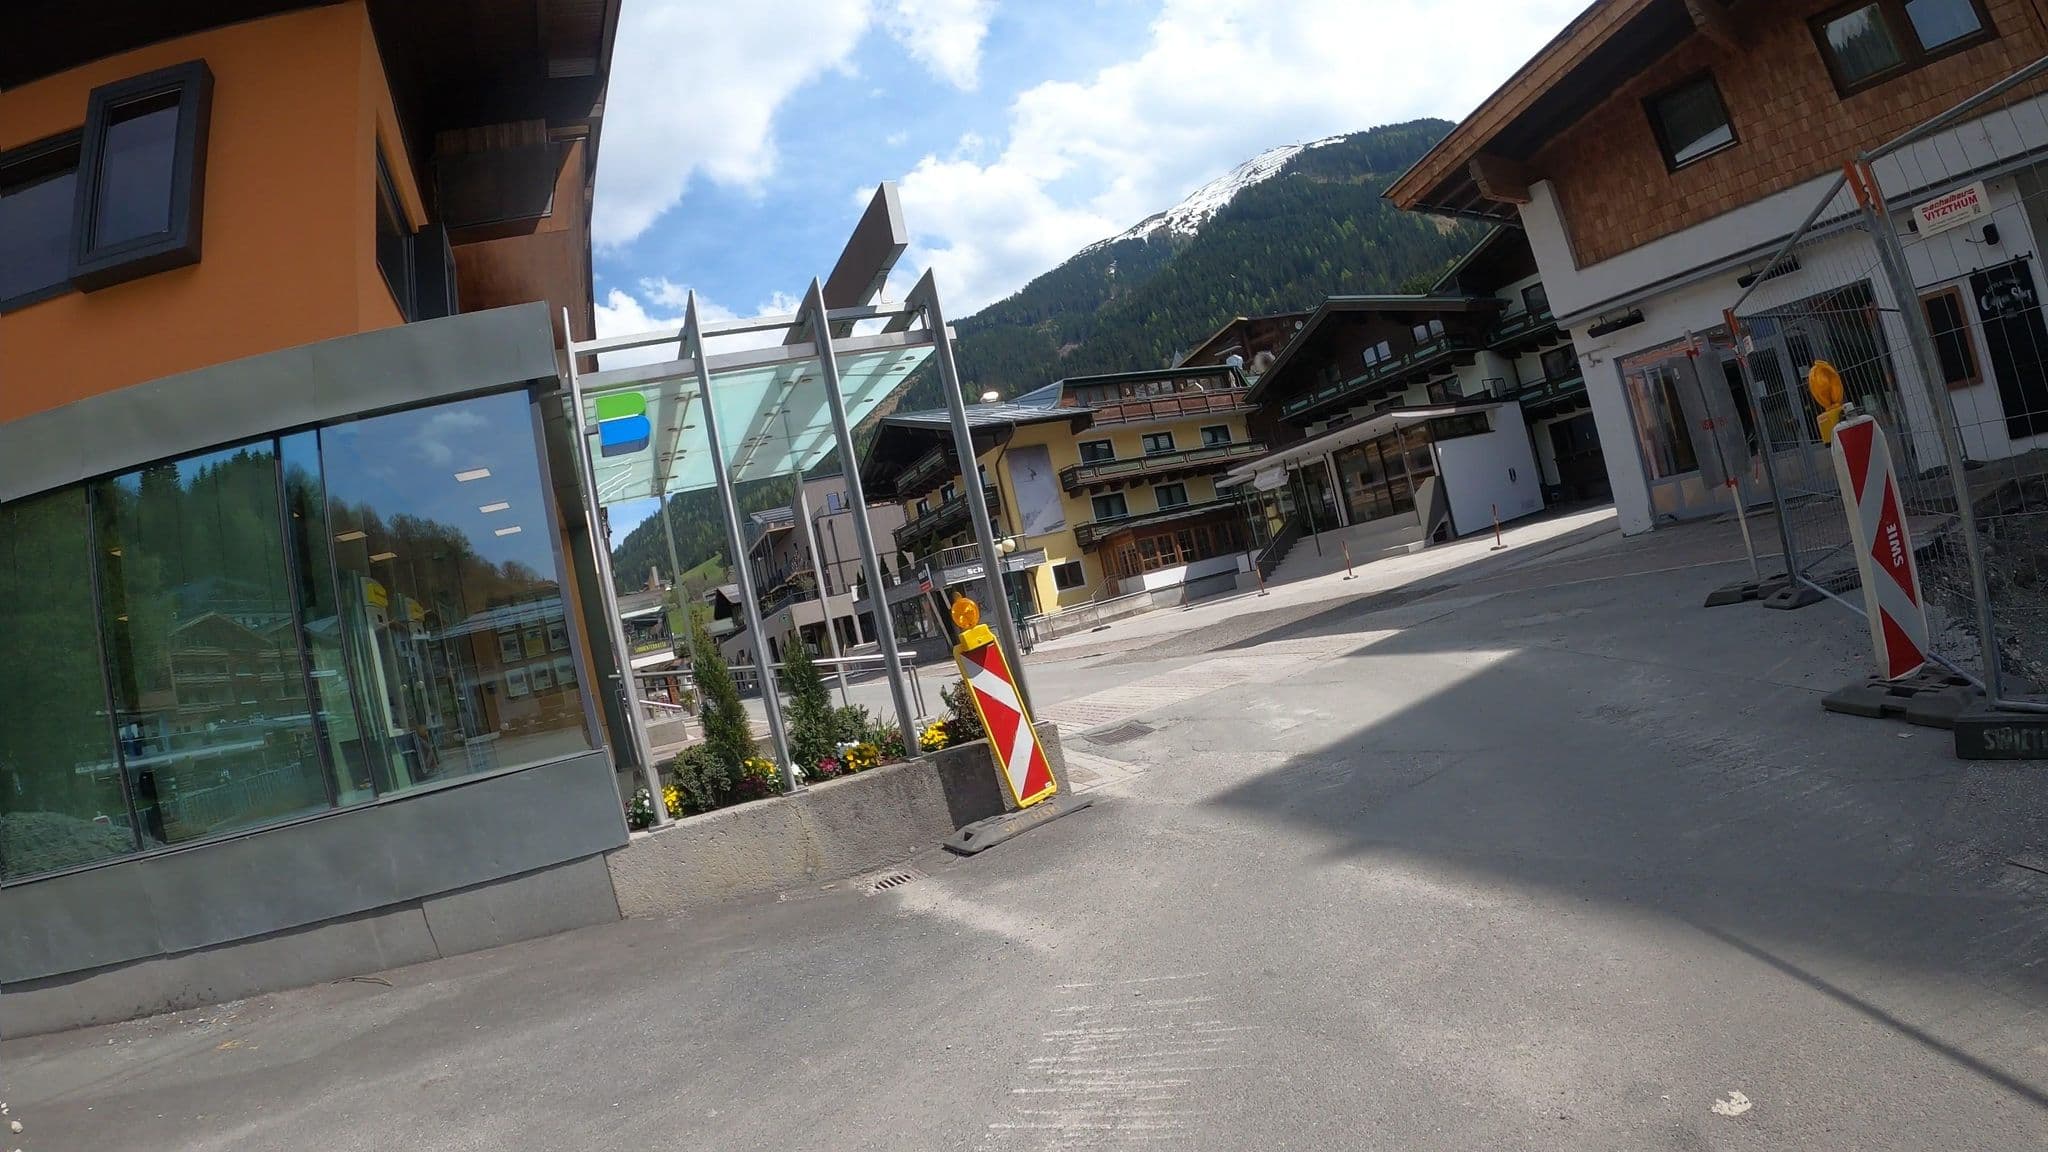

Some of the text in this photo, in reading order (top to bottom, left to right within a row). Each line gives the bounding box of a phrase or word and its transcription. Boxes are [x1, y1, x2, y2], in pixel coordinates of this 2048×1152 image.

[1924, 194, 1978, 222] VITZTHUM
[1886, 523, 1904, 568] SWIE
[967, 566, 984, 575] Sch
